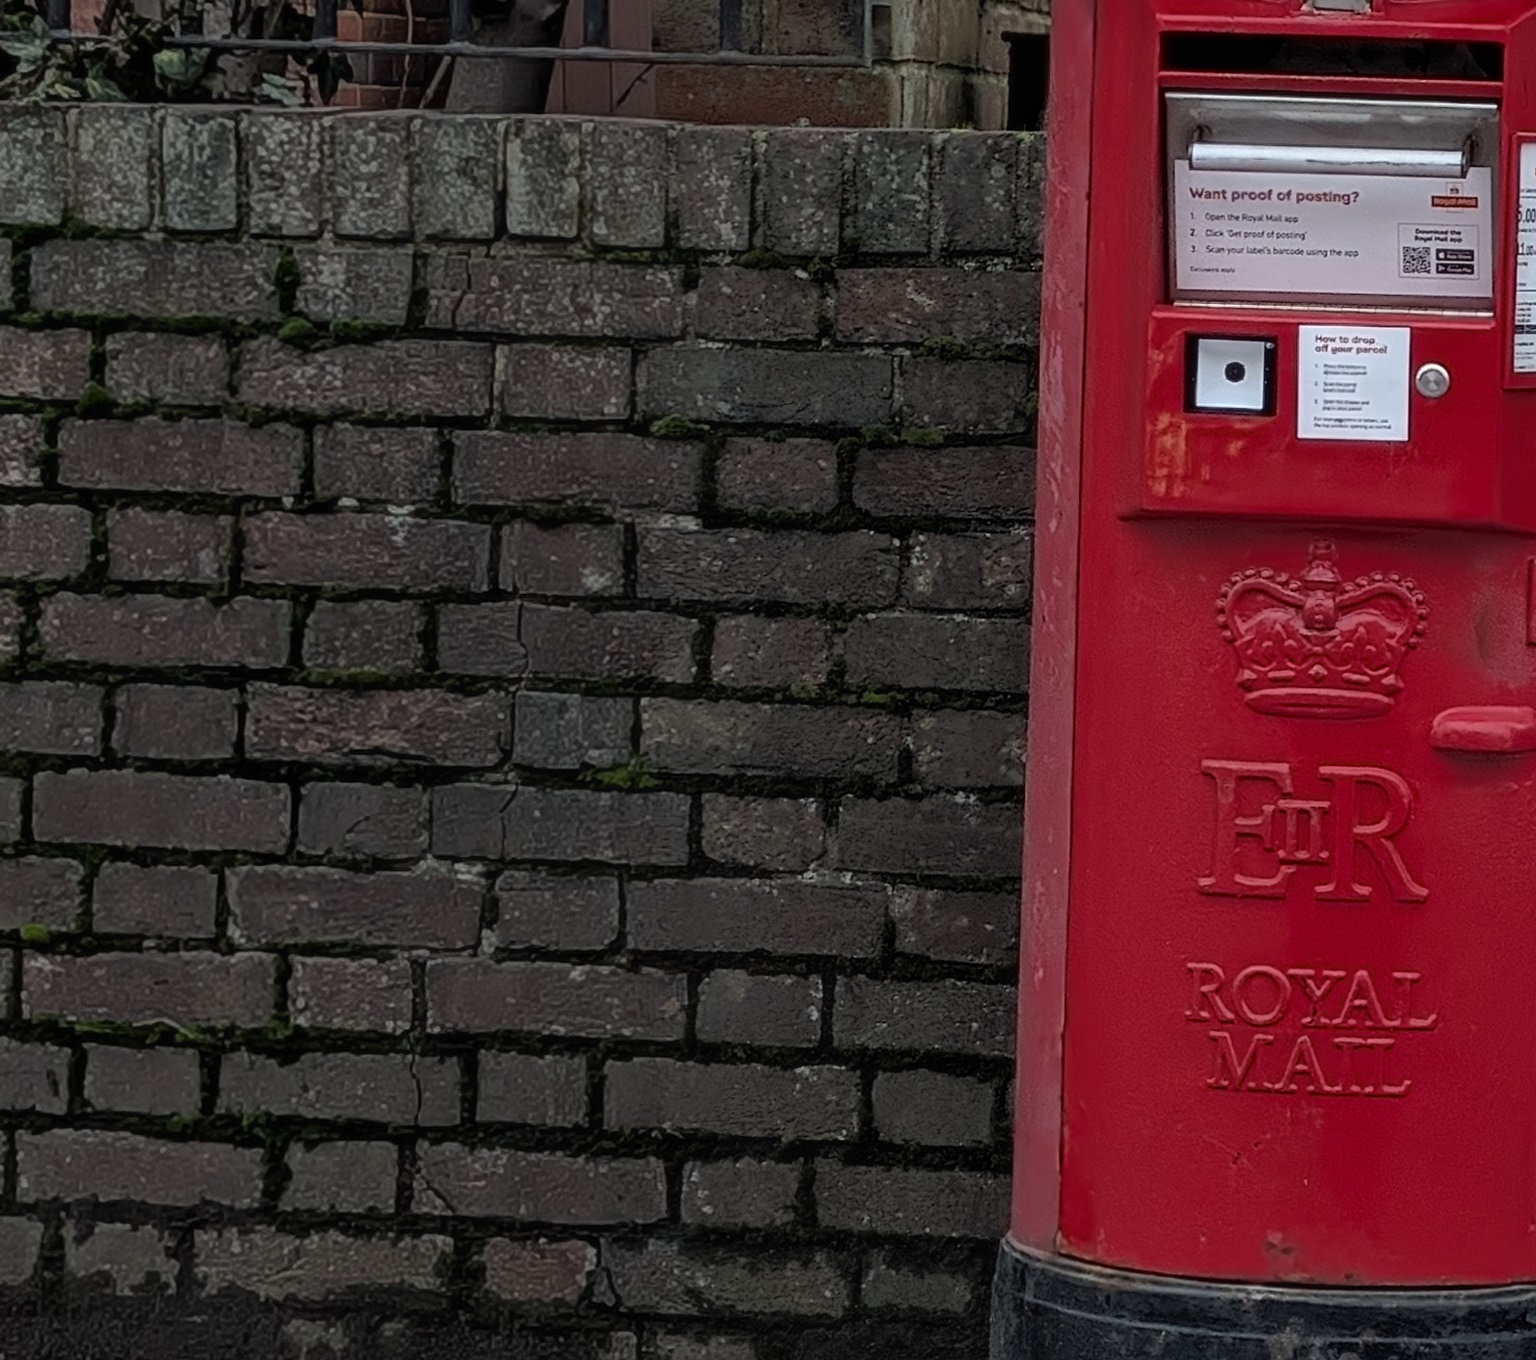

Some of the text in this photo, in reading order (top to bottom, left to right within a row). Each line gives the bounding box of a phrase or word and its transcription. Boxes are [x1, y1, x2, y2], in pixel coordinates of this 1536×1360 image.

[1189, 187, 1360, 205] Want proof of posting?
[1204, 213, 1226, 222] Open
[1227, 214, 1240, 222] the
[1241, 214, 1264, 223] Royal
[1265, 214, 1282, 223] Mail
[1284, 216, 1299, 224] app
[1205, 229, 1224, 237] Click
[1243, 230, 1265, 239] proof
[1266, 231, 1275, 239] of
[1205, 245, 1225, 254] Scan
[1226, 247, 1244, 255] your
[1273, 247, 1304, 256] barcode
[1306, 248, 1328, 258] using
[1329, 249, 1342, 257] the
[1343, 250, 1359, 258] app
[1315, 335, 1376, 345] How to drop
[1315, 345, 1388, 355] off your parcel
[1184, 961, 1438, 1030] ROYAL
[1205, 1030, 1412, 1096] MAIL
